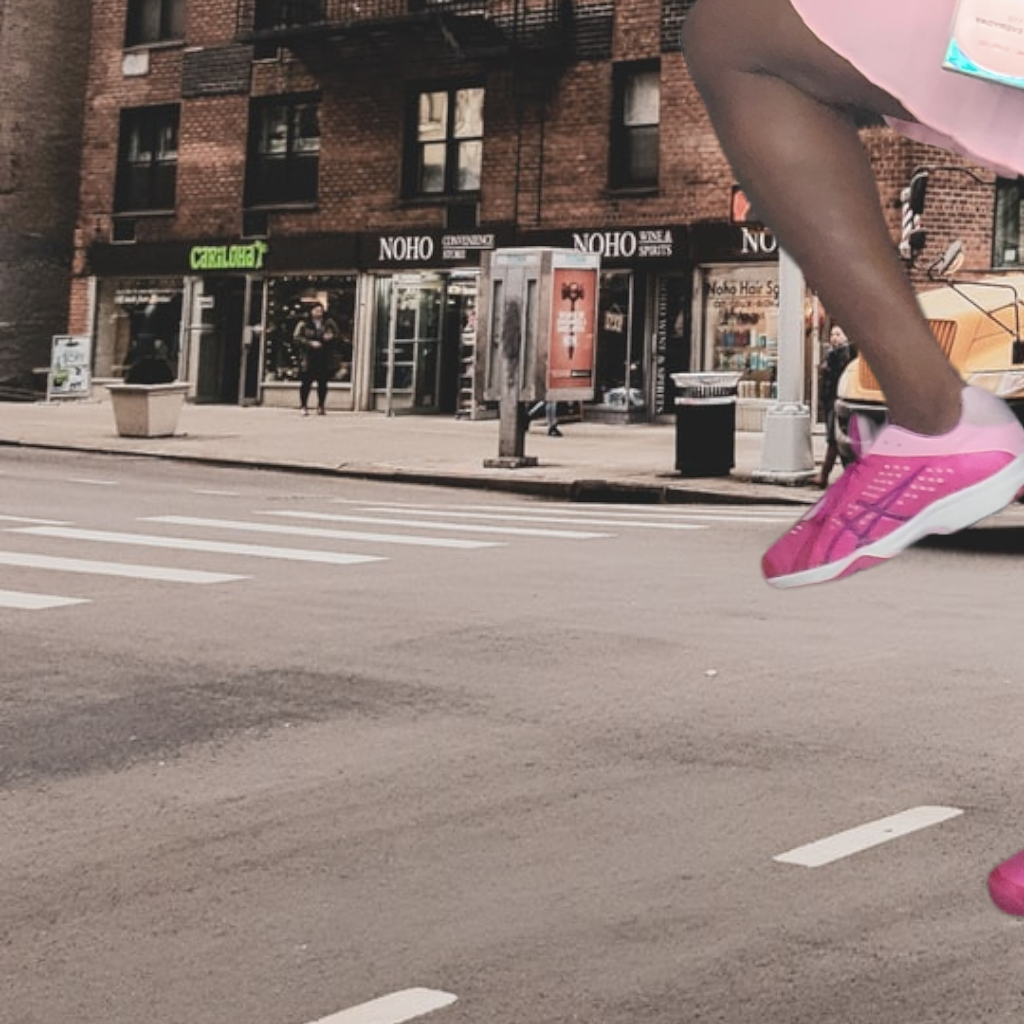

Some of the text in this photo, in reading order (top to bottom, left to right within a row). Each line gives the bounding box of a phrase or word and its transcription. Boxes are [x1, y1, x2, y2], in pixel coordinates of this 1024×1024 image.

[442, 234, 495, 247] CONVENIENCE
[571, 231, 637, 257] NOHO
[378, 236, 434, 261] NOHO
[638, 245, 673, 257] SPIRITS
[740, 279, 763, 294] Hair
